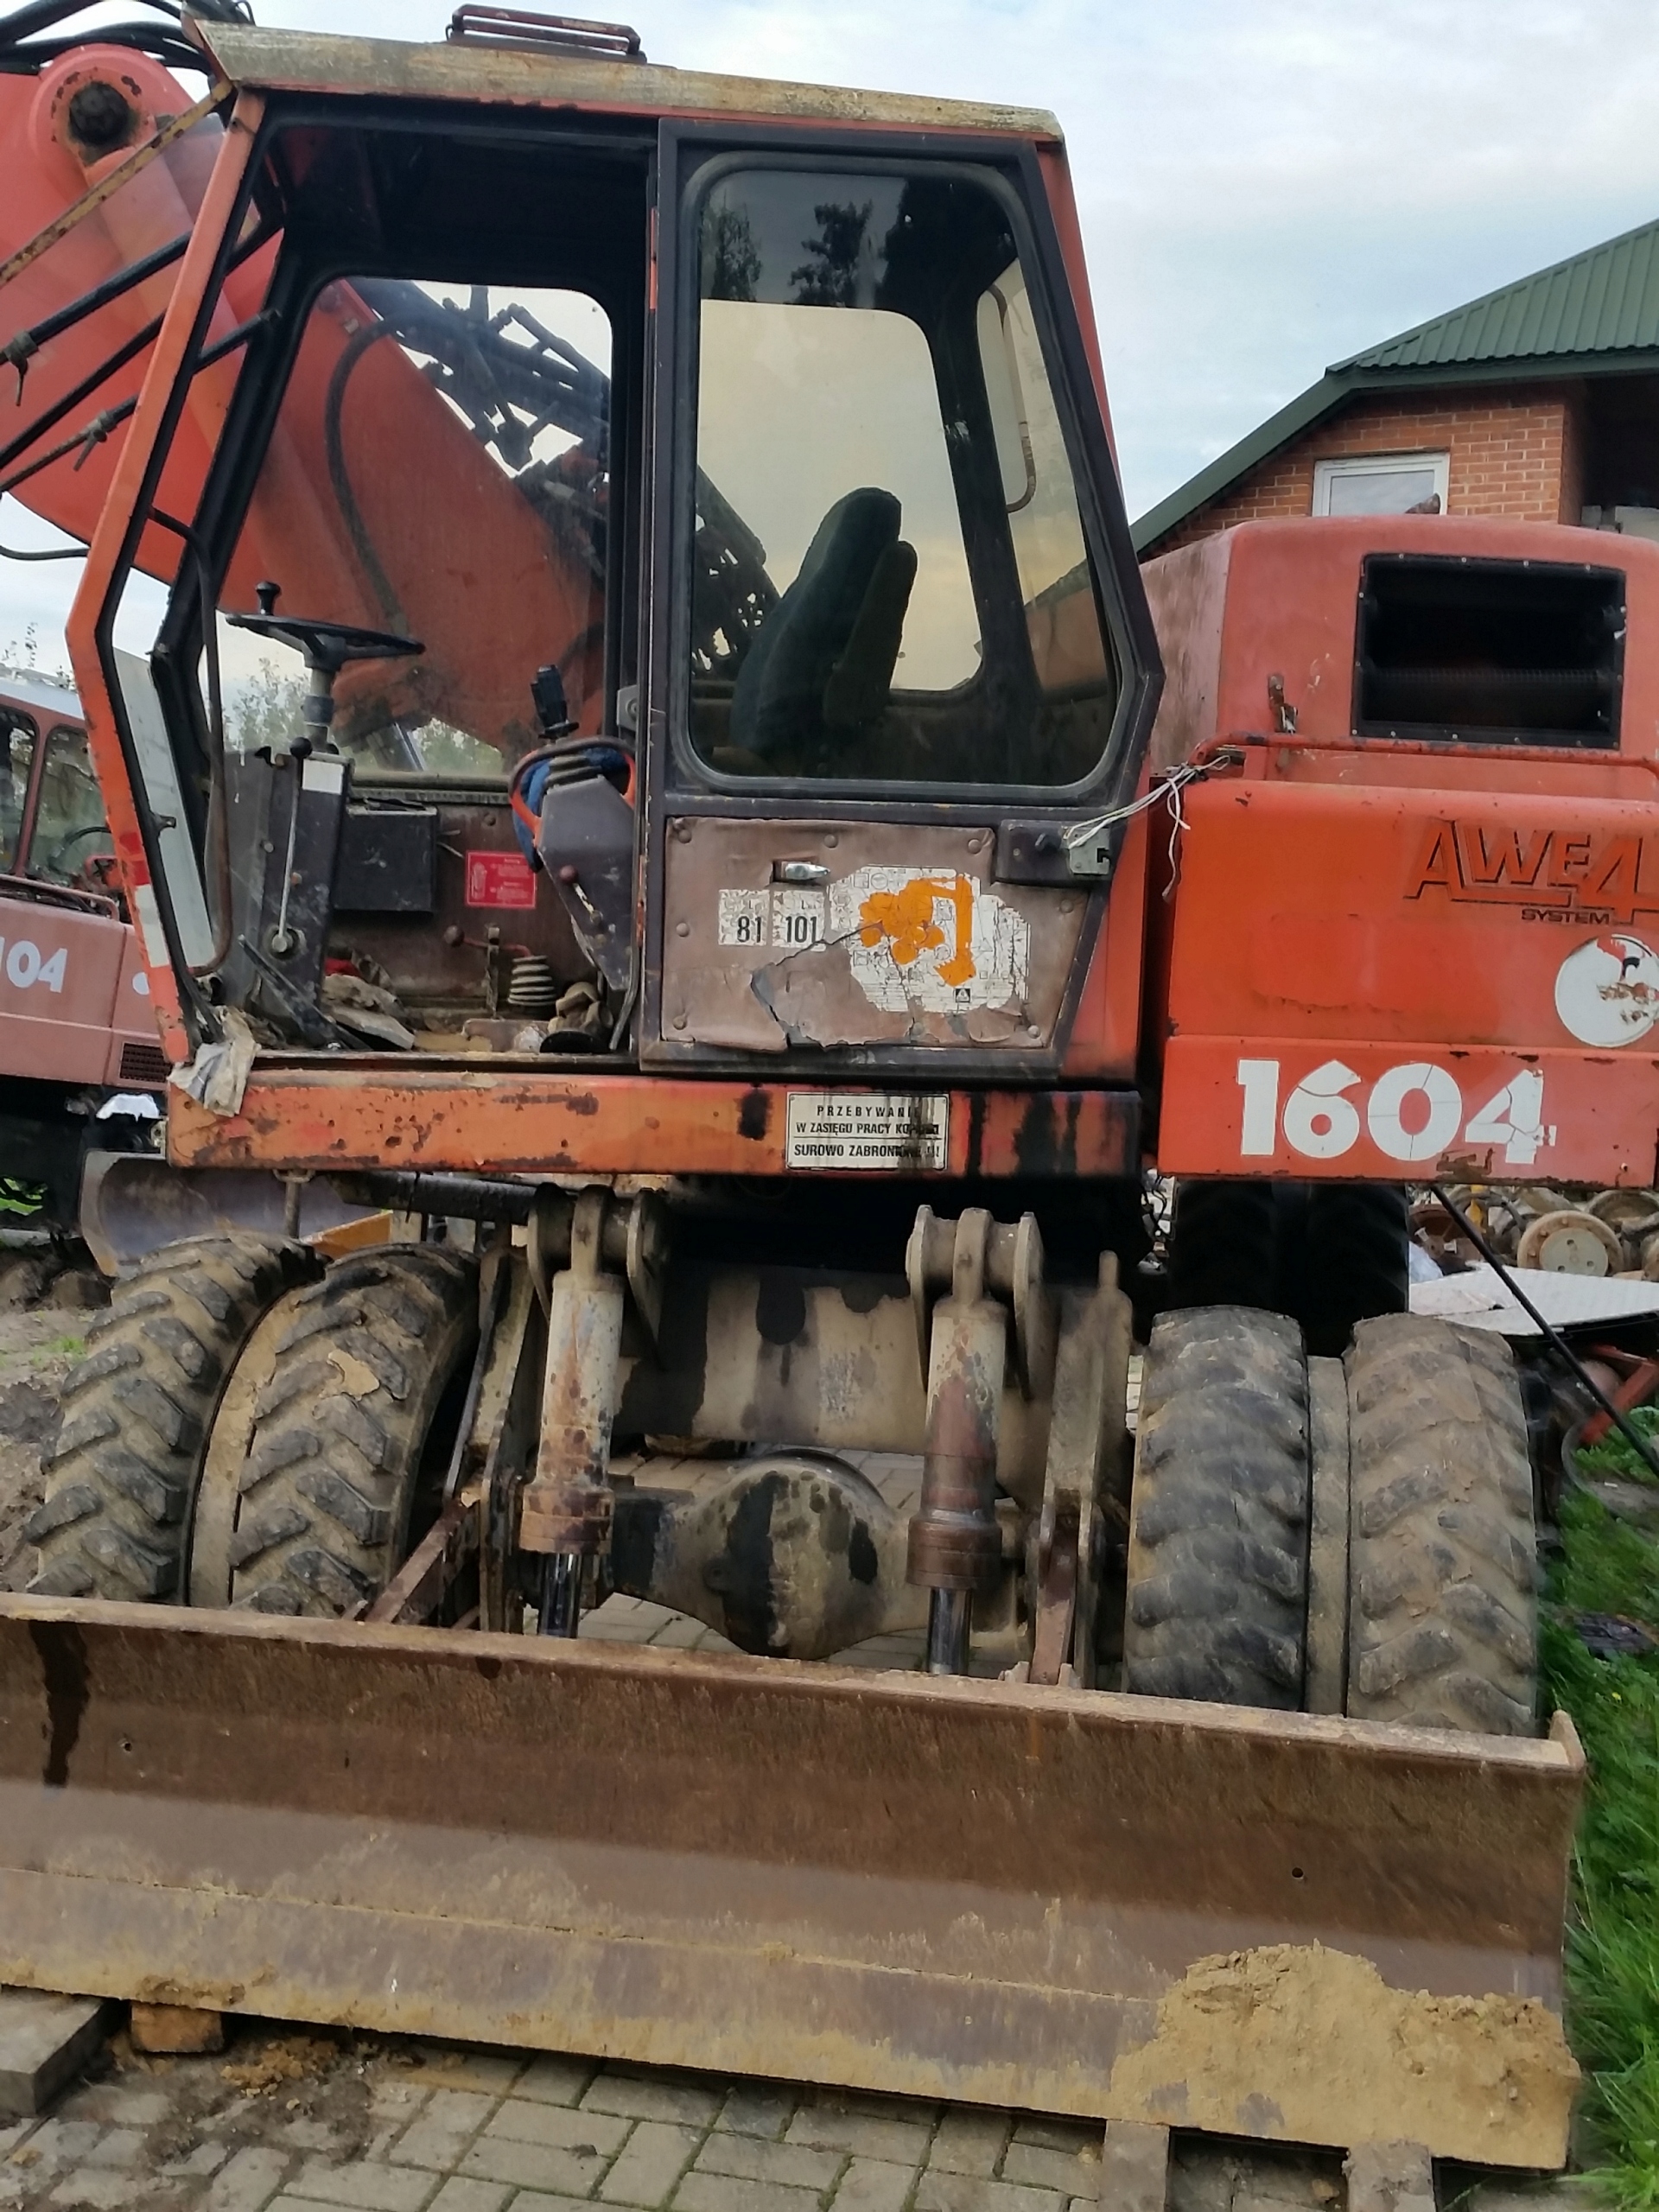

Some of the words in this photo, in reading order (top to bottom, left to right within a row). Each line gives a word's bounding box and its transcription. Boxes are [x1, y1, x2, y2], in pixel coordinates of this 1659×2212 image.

[1521, 908, 1610, 925] SYSTEM
[737, 916, 761, 944] 81
[785, 916, 817, 944] 101
[0, 936, 68, 994] 04
[817, 1104, 921, 1119] PRZEBYWANI
[1236, 1057, 1557, 1165] 1604
[796, 1122, 806, 1134] W
[810, 1122, 853, 1136] ZASIĘGU
[856, 1123, 891, 1135] PRACY
[794, 1144, 844, 1157] SUROWO
